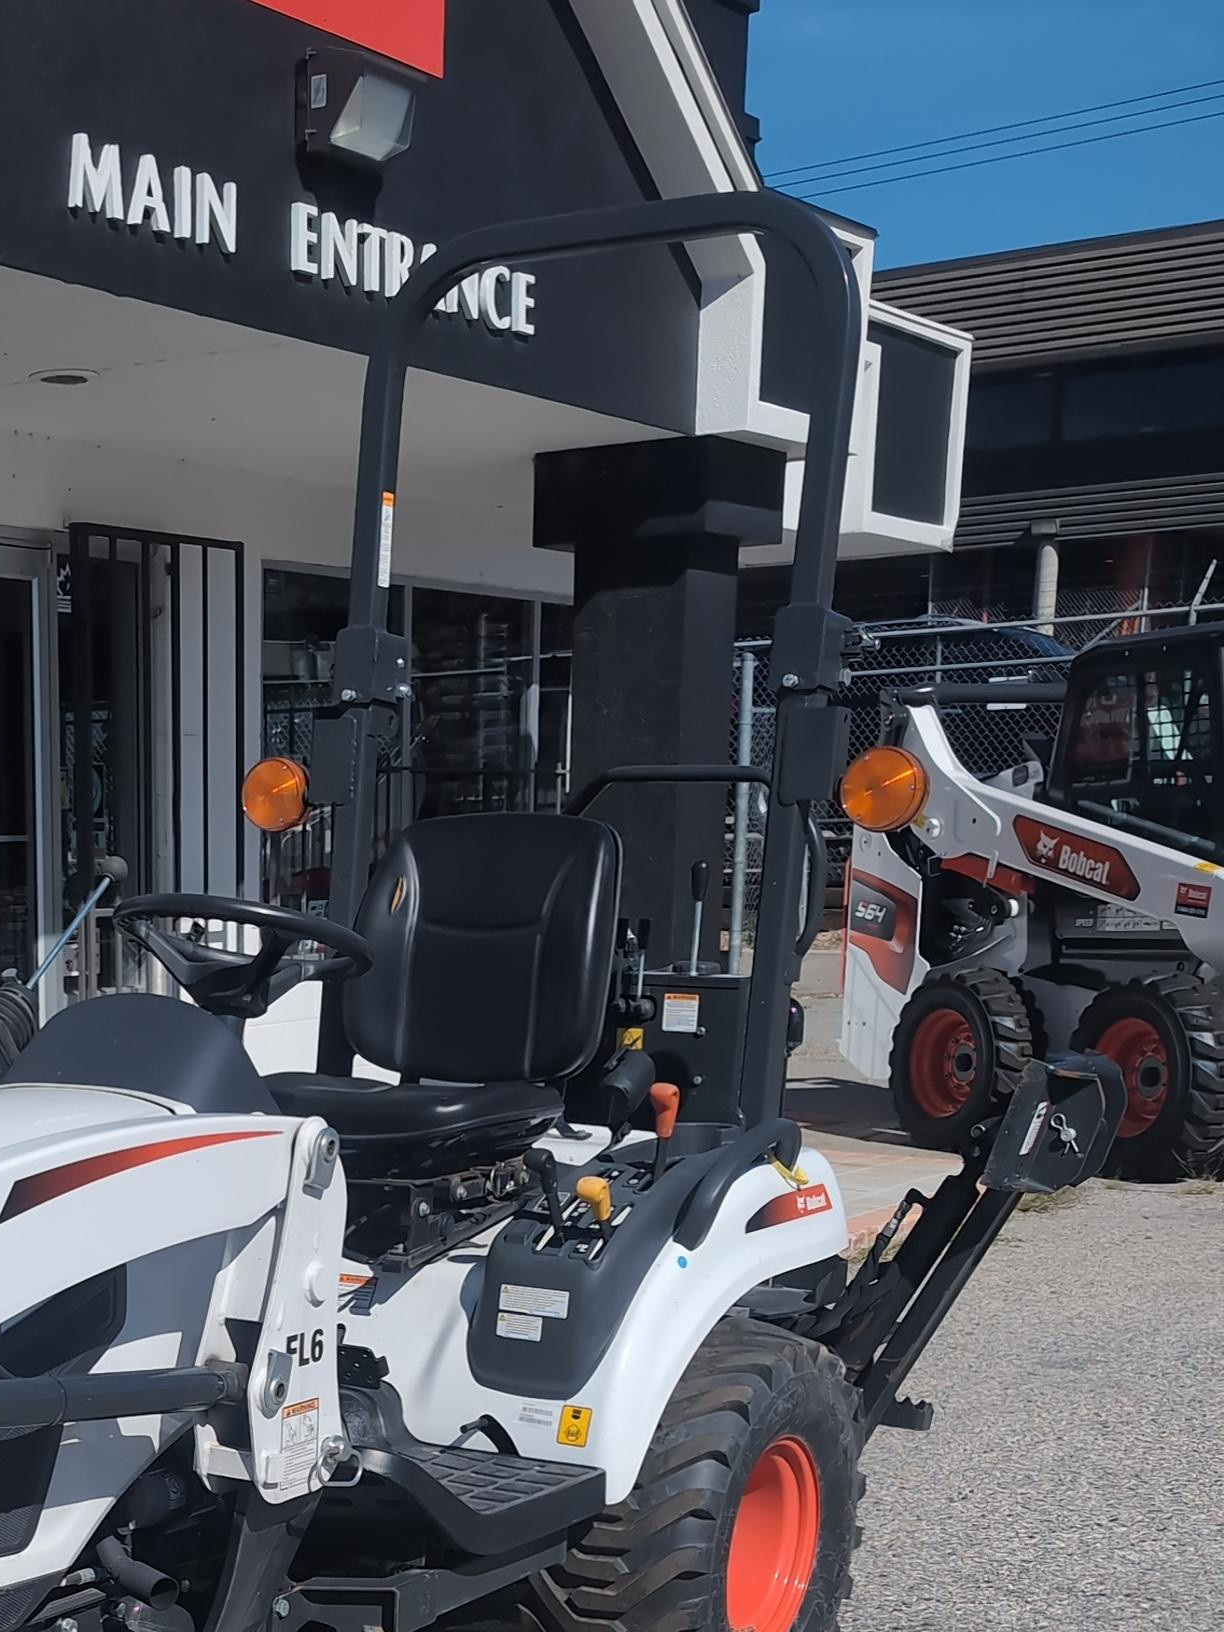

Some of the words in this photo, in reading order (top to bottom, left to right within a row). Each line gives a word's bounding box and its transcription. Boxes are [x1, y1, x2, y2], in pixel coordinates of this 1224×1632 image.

[68, 132, 237, 254] MAIN
[1058, 845, 1111, 885] Bobcat
[286, 1328, 324, 1367] FL6
